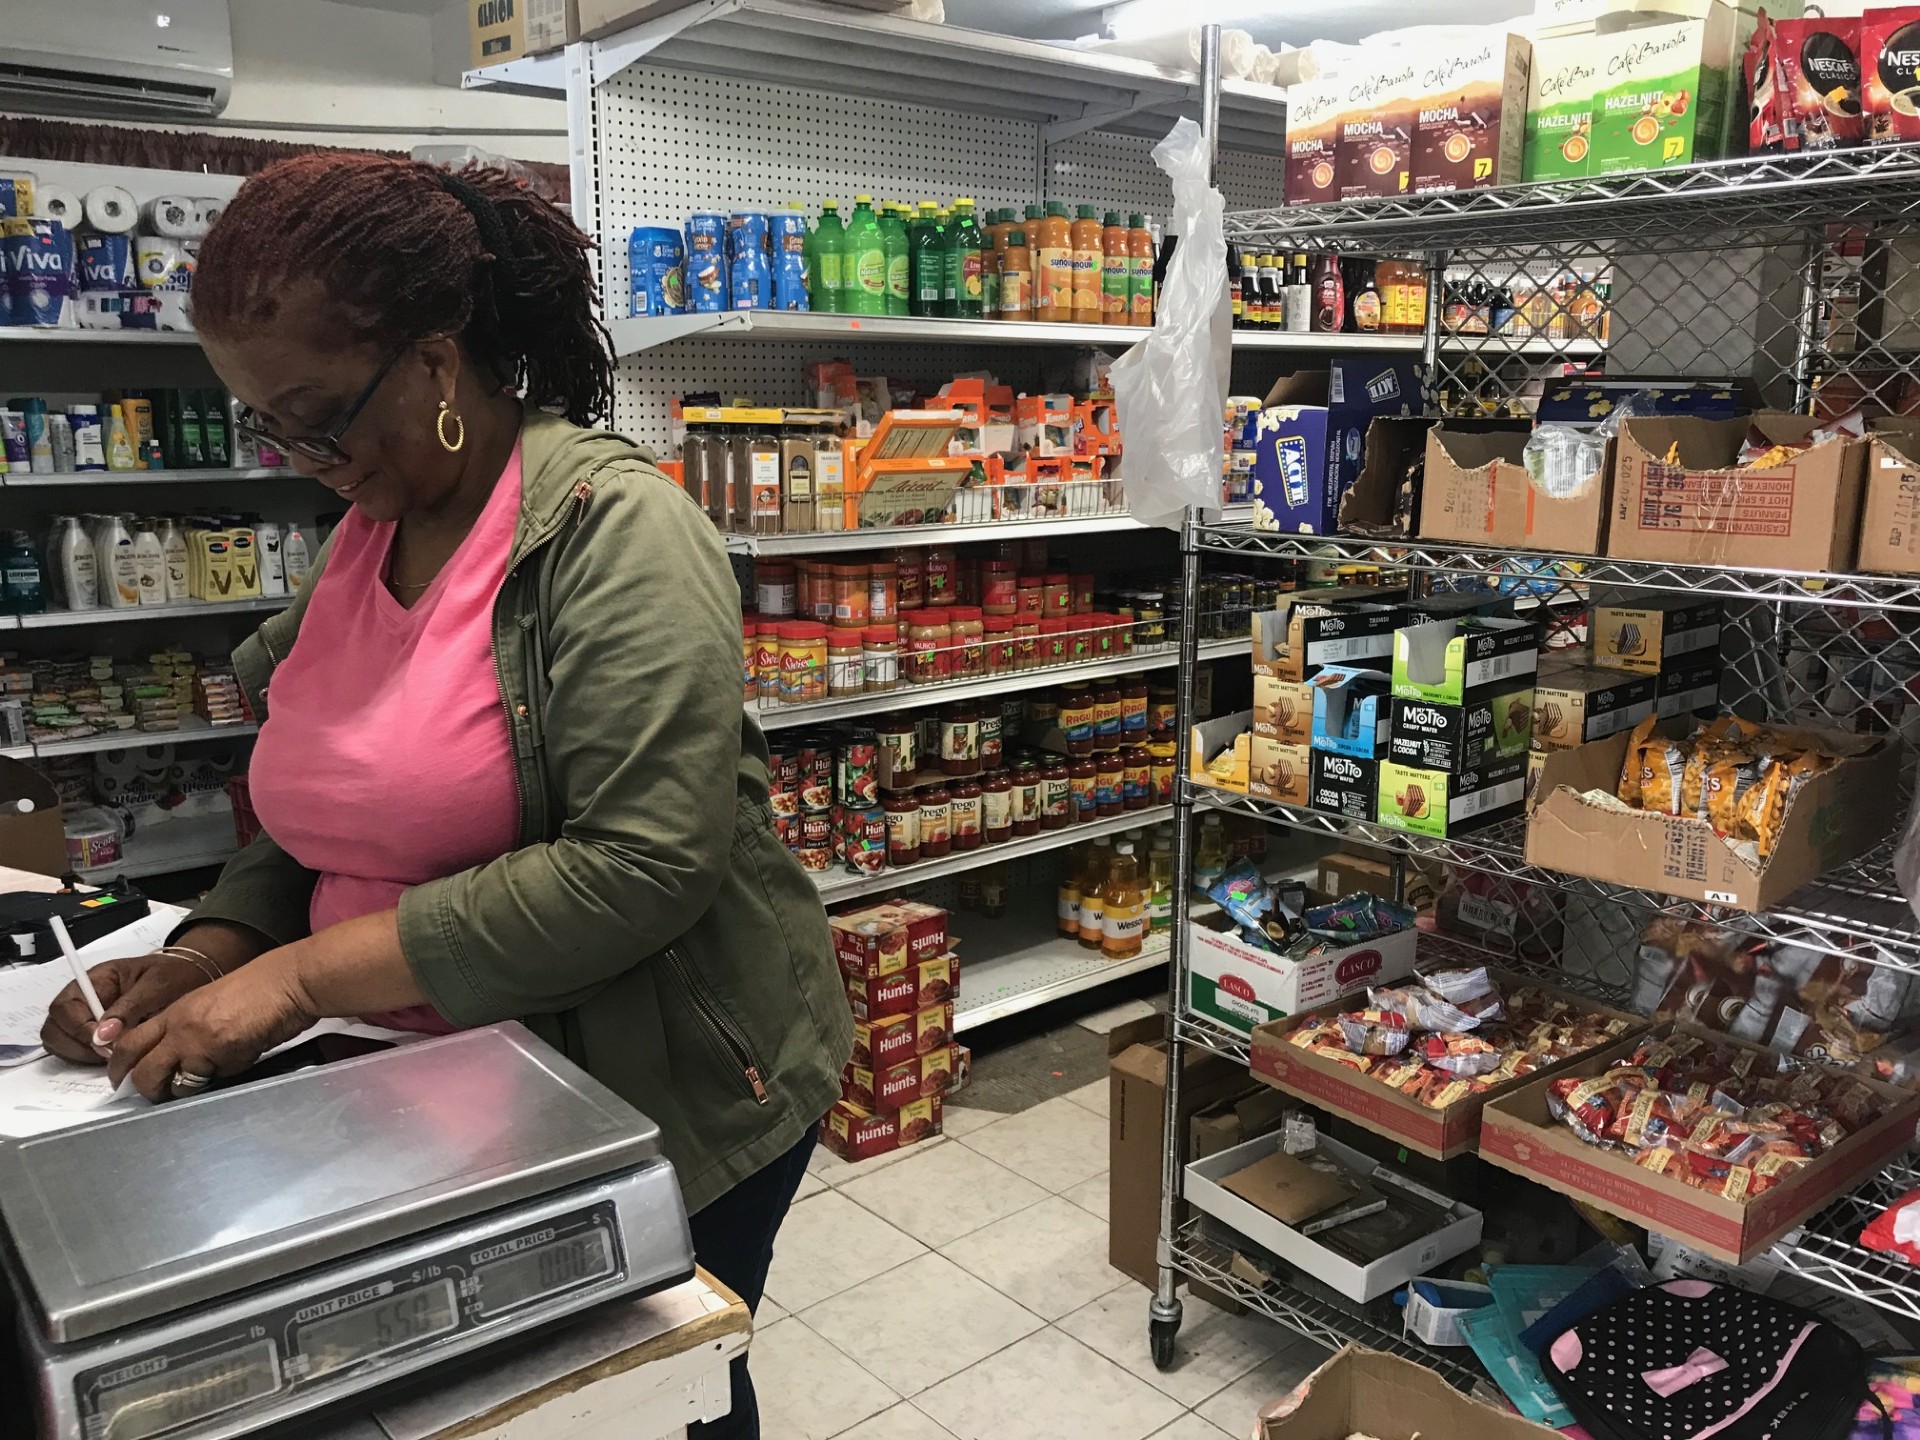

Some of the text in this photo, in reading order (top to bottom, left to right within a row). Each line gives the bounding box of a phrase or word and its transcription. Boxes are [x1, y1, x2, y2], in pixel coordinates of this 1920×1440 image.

[1604, 90, 1664, 111] HAZELNUT
[1419, 107, 1459, 124] MOCHA
[1537, 112, 1593, 129] HAZELNUT
[1344, 121, 1384, 137] MOCHA
[1291, 138, 1324, 153] MOCHA
[1669, 142, 1680, 155] 7
[1477, 161, 1488, 178] 7
[10, 244, 63, 271] Viva
[85, 264, 115, 281] iva
[1045, 413, 1070, 423] TURBO
[1756, 481, 1791, 491] HONEY
[1767, 496, 1789, 505] HOT
[1743, 509, 1788, 519] PEANUTS
[1744, 522, 1787, 533] CASHEW
[913, 641, 936, 650] VALRICO
[760, 652, 779, 665] Swi
[785, 656, 810, 671] Swiss
[1403, 722, 1438, 734] CRISPY WAFER
[1393, 737, 1421, 748] HAZELNUT
[1397, 746, 1417, 756] COCOA
[1323, 772, 1355, 783] CRISPY WAFER
[1394, 769, 1431, 780] TASTE MATTERS
[1319, 788, 1339, 800] COCOA
[950, 799, 976, 814] rego
[1319, 796, 1339, 808] COCOA
[885, 814, 903, 827] ego
[950, 959, 959, 968] 12
[1340, 956, 1375, 977] LASCO
[1223, 979, 1250, 997] LASCO
[945, 1004, 953, 1014] 12
[951, 1047, 959, 1056] 12
[932, 1096, 941, 1106] 12
[473, 1230, 553, 1264] TOTAL PRICE
[299, 1285, 381, 1321] UNIT PRICE
[250, 1325, 266, 1339] lb
[100, 1358, 166, 1386] WEIGHT
